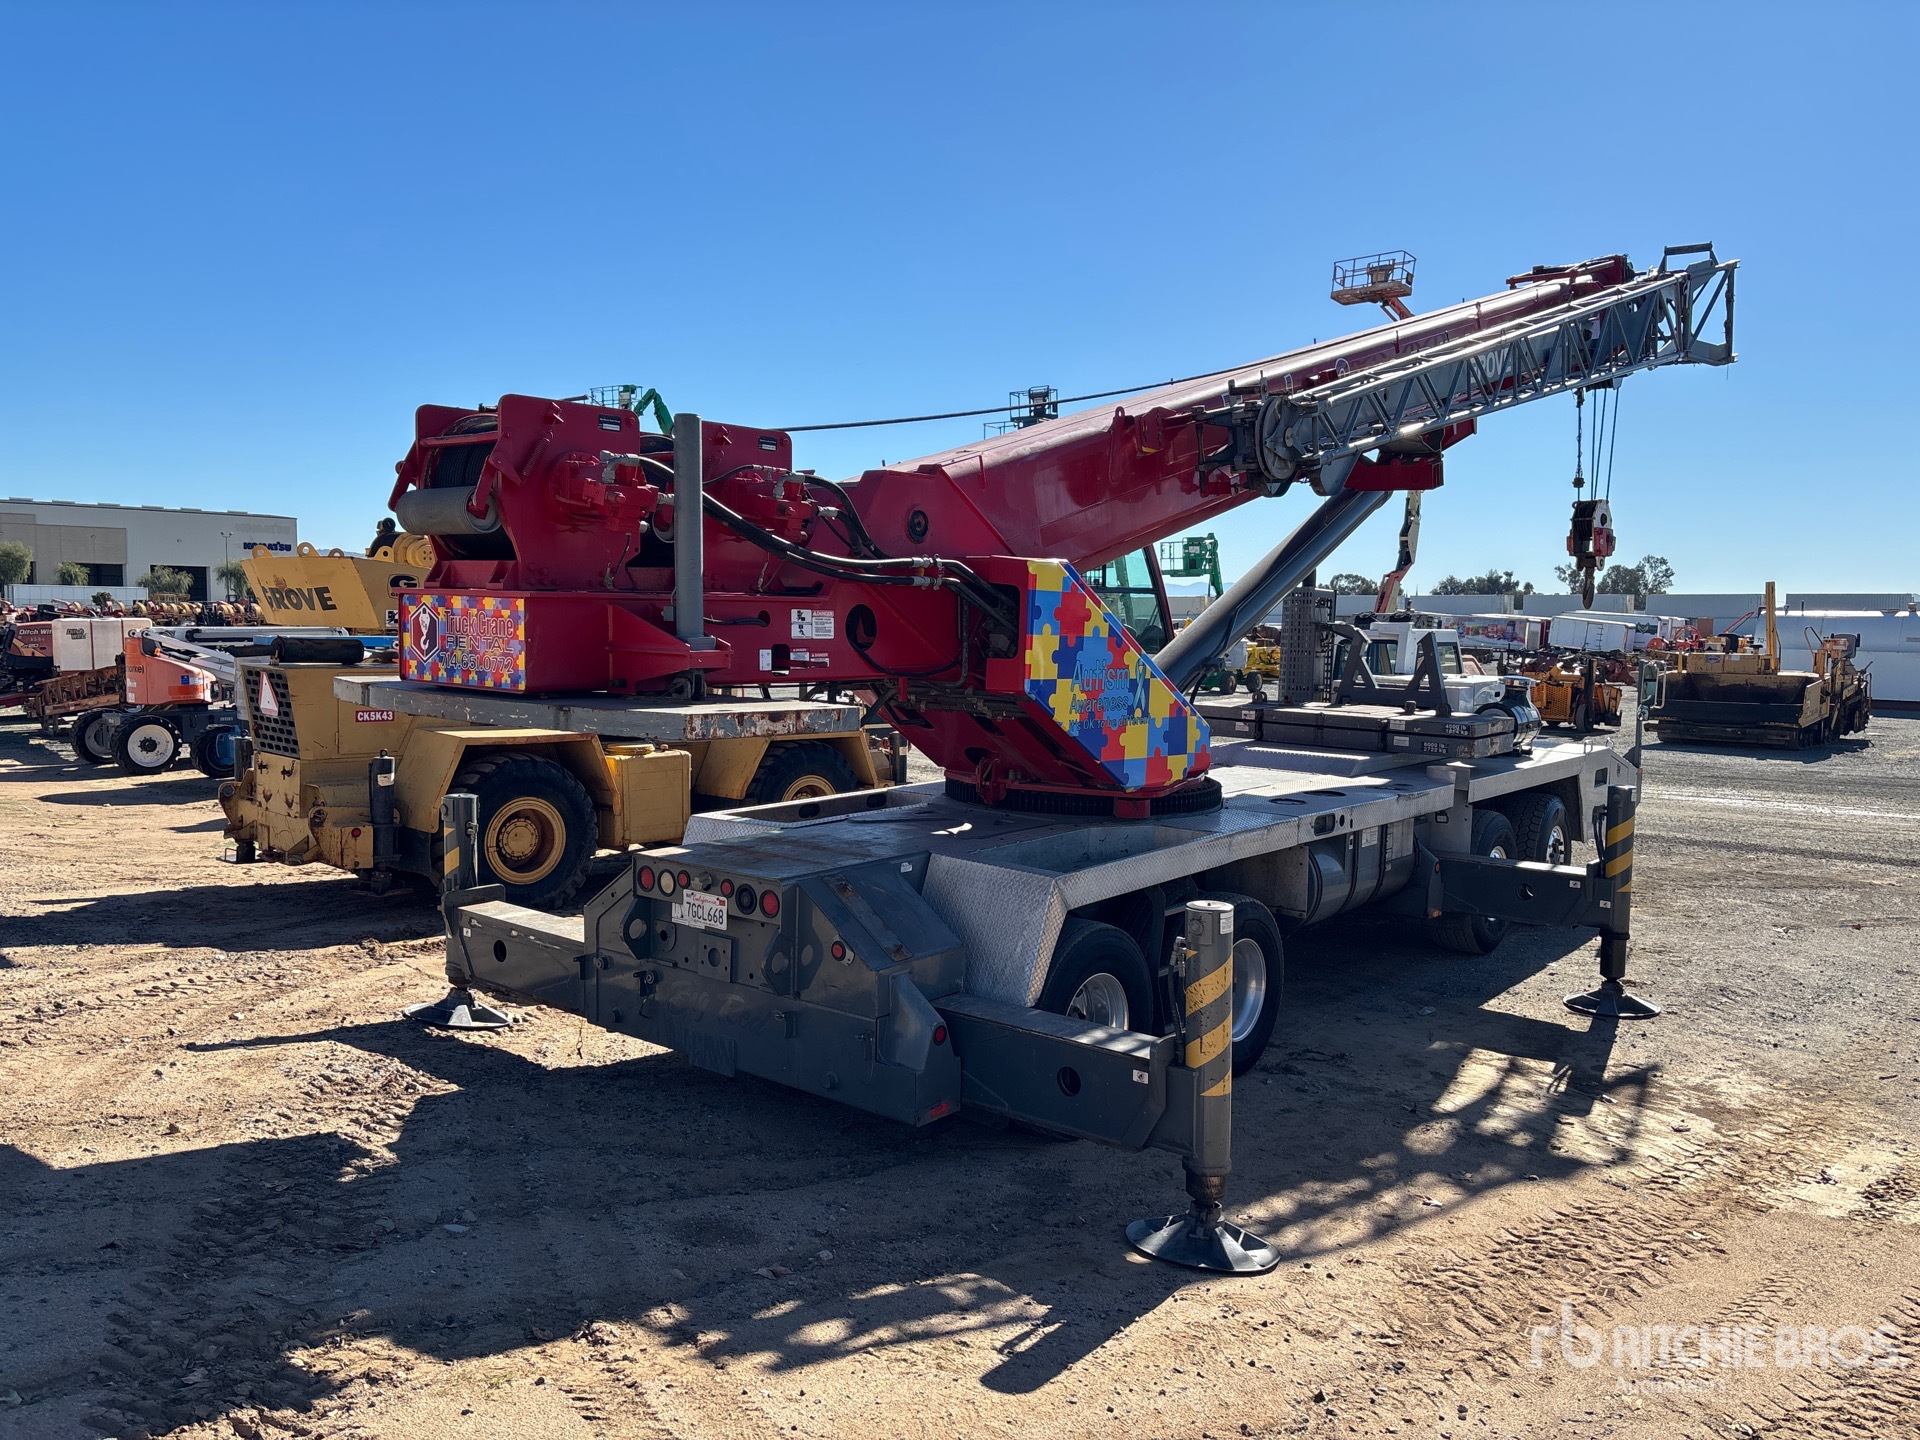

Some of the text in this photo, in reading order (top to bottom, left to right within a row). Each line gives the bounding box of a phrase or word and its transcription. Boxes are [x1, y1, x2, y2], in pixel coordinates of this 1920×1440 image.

[261, 586, 338, 611] GROVE
[444, 610, 514, 637] Truck Crane
[446, 635, 514, 653] RENTAL
[440, 652, 514, 673] 714.651.0772
[1070, 659, 1131, 692] Autism
[1069, 694, 1129, 714] Awareness
[357, 711, 393, 721] CK5K43
[1083, 718, 1095, 730] OK
[1097, 718, 1105, 728] to
[1107, 716, 1118, 728] be
[1119, 713, 1151, 727] different
[692, 893, 718, 906] California
[686, 902, 724, 924] 7GCL668
